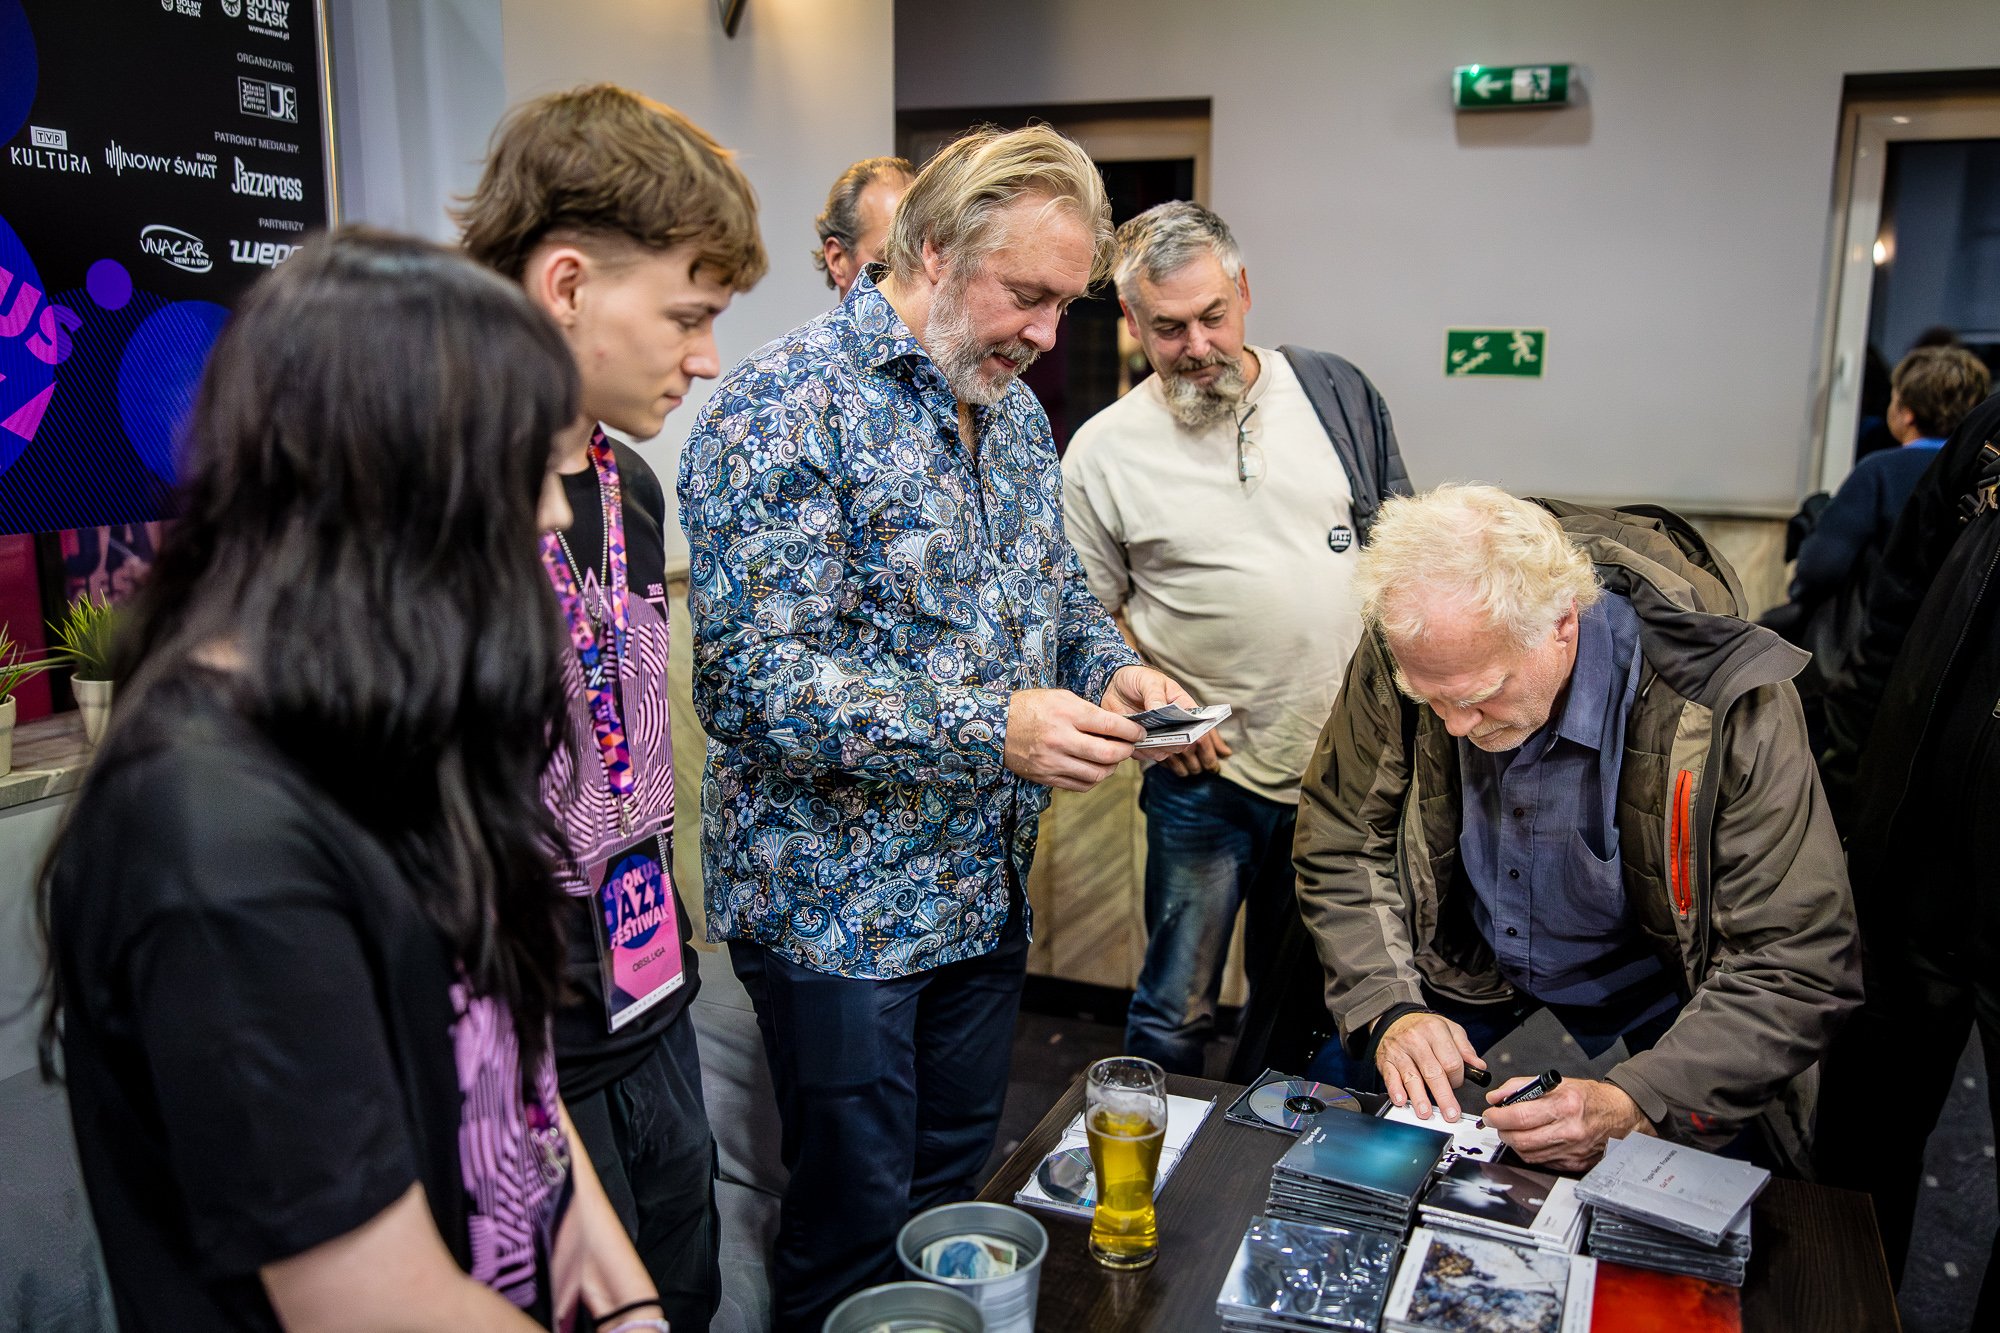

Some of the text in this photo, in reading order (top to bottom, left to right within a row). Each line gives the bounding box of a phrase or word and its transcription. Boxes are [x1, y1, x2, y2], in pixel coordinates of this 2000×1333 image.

[37, 131, 61, 143] TVP
[214, 131, 257, 148] PATRONAT
[10, 146, 91, 174] KULTURA
[122, 151, 217, 179] NOWY ŚWIAT
[196, 152, 217, 163] RADIO
[231, 156, 303, 202] Jazzpress
[258, 217, 304, 232] PARTNERZY
[139, 237, 209, 259] VIVACAR
[173, 256, 190, 265] RENT
[610, 904, 669, 951] FESTIWAL
